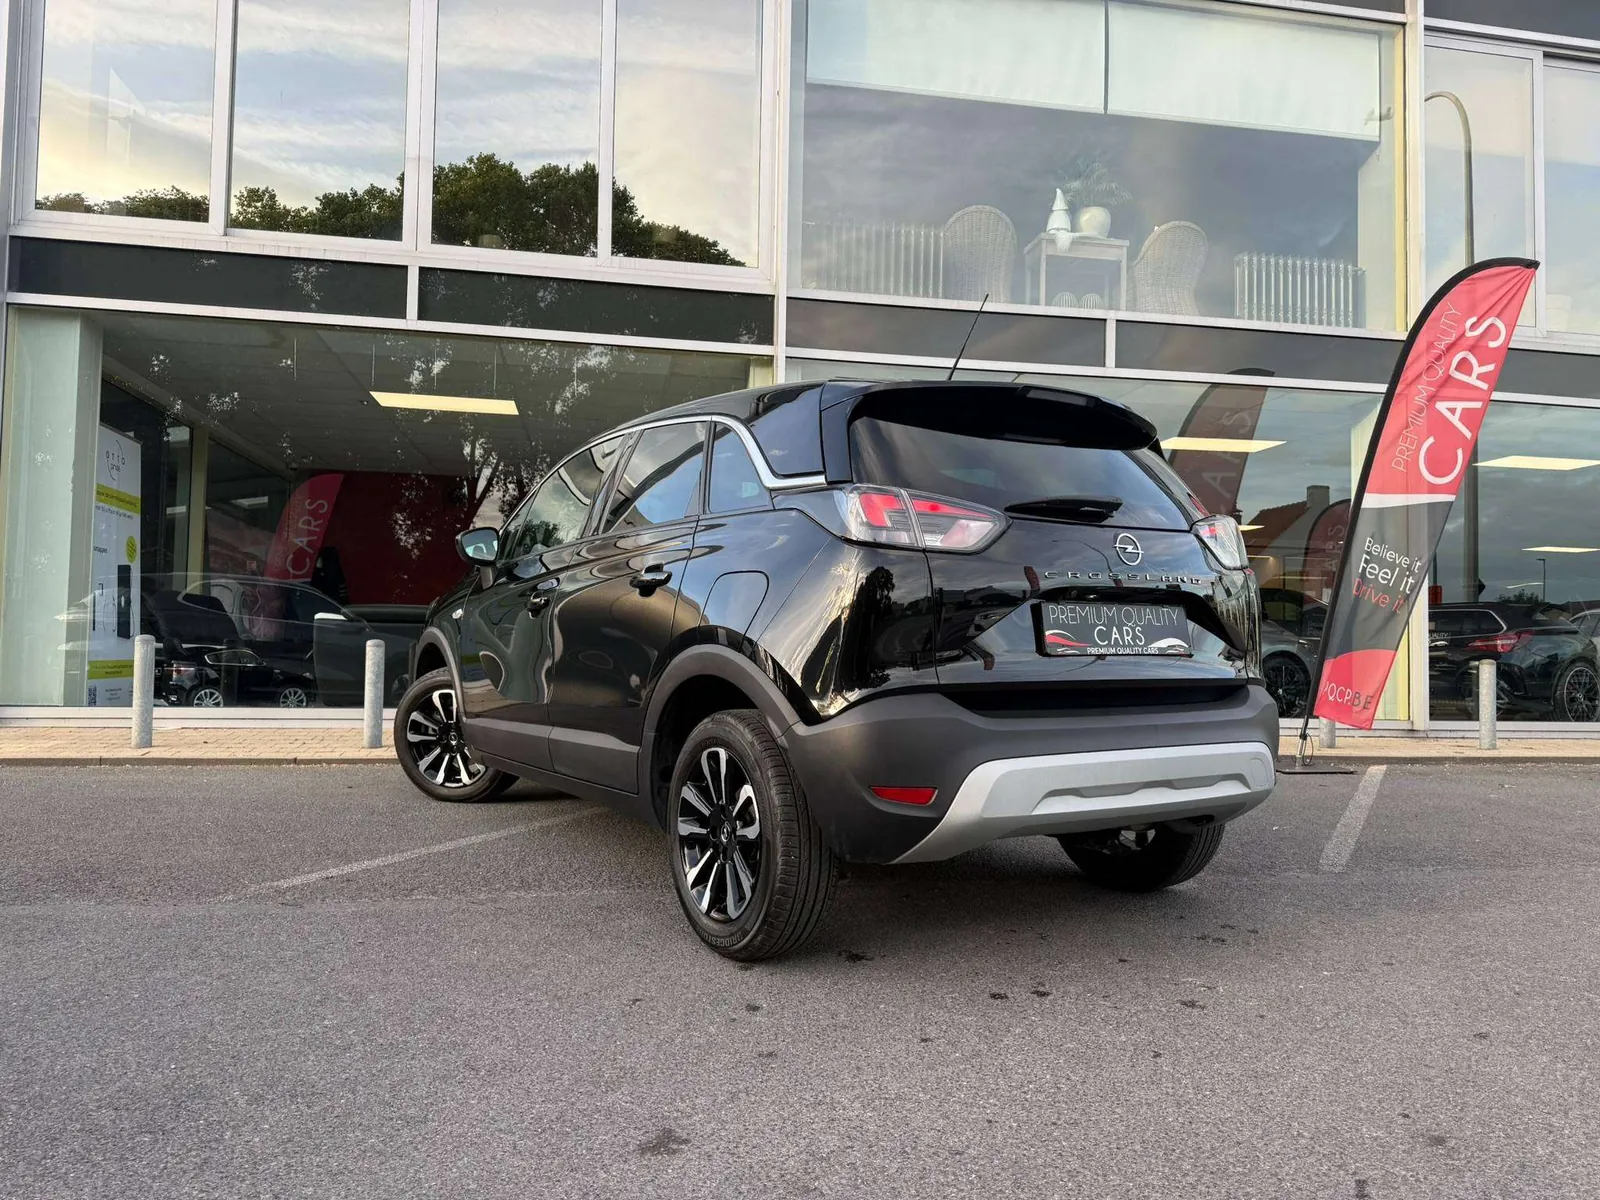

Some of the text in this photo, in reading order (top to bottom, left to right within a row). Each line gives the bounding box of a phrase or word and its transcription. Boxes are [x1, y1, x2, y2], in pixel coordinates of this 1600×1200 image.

[1392, 302, 1462, 473] PREMIUM QUALITY
[1418, 315, 1507, 485] CARS
[286, 499, 328, 575] CARS
[1364, 536, 1422, 573] Believe it
[1045, 571, 1202, 585] CROSSLAND
[1358, 553, 1415, 594] Feel it
[1352, 577, 1405, 614] Drive it
[1048, 605, 1178, 627] PREMIUM QUALITY
[1086, 647, 1159, 655] PREMIUM QUALITY CARS
[1094, 626, 1145, 645] CARS
